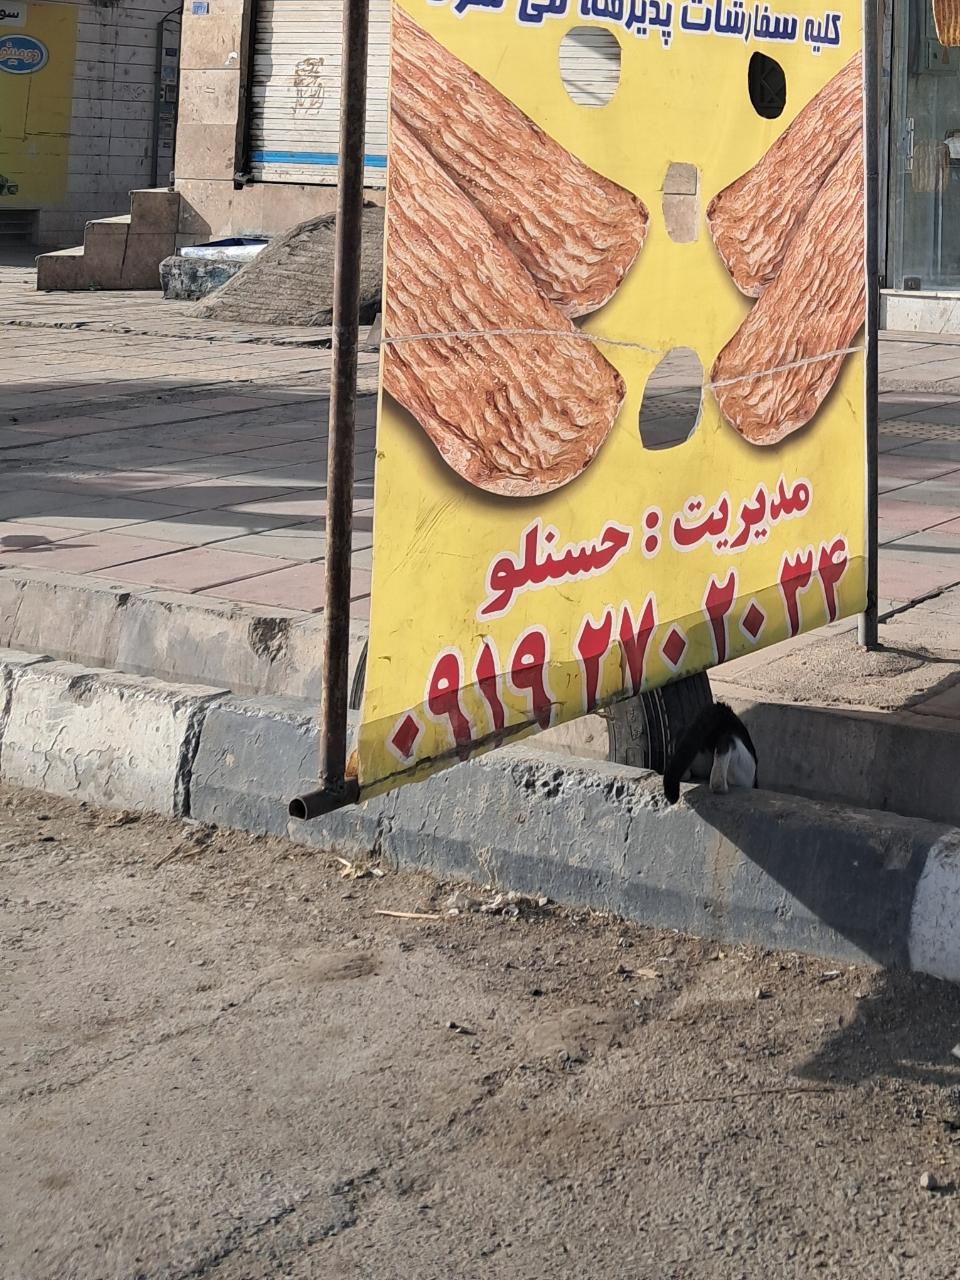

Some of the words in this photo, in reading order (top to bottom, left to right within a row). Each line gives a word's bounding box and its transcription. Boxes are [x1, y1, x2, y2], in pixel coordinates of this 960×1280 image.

[803, 12, 843, 54] کلیه
[673, 477, 813, 550] مدیریت
[479, 522, 632, 616] حسنلو
